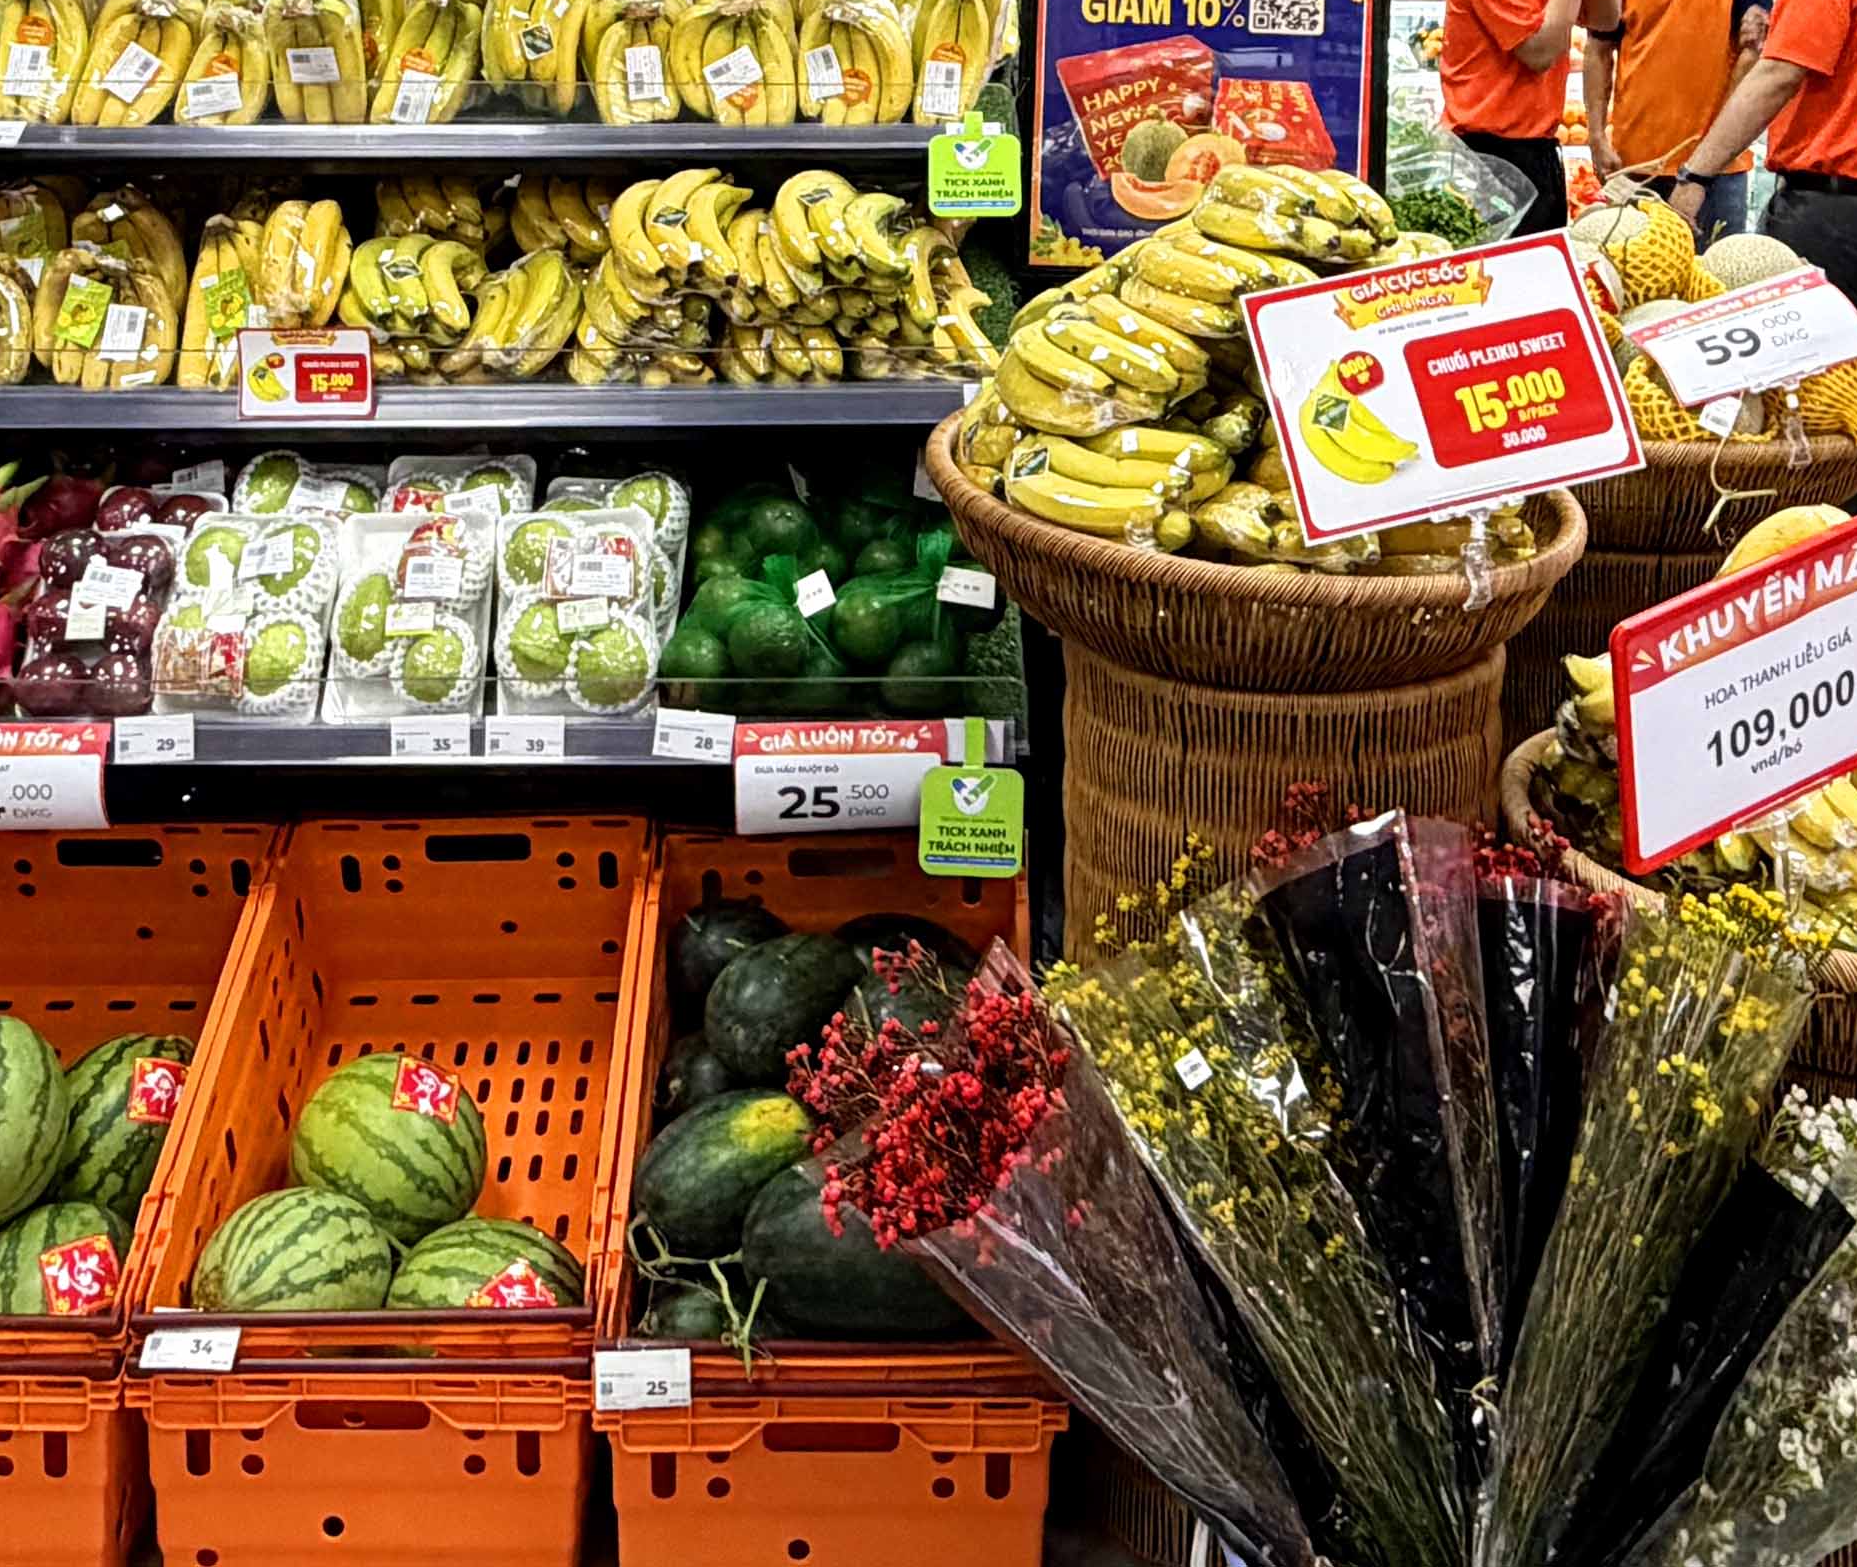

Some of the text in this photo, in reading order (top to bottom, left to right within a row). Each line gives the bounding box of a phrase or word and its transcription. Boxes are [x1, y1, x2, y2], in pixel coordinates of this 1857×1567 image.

[1083, 77, 1160, 111] HAPPY
[944, 177, 1005, 188] TICK XANH
[936, 187, 1014, 200] TRÁCH NHIỆM
[1350, 260, 1468, 303] GIÁ CỰC SỐC
[1427, 331, 1566, 377] CHUỐI PLEIKU SWEET
[1454, 368, 1566, 434] 15.000
[1657, 568, 1806, 672] KHUYẾN
[1704, 627, 1853, 710] HOA THANH LIỄU GIÁ
[1706, 669, 1855, 769] 109,000
[22, 726, 62, 752] TỐT
[156, 737, 175, 752] 29
[432, 737, 453, 752] 35
[524, 737, 547, 752] 39
[693, 735, 714, 751] 28
[760, 724, 899, 752] GIÁ LUÔN TỐT
[9, 783, 52, 802] .000
[777, 783, 890, 820] 25 .500
[936, 824, 1007, 839] TICK XANH
[927, 839, 1016, 856] TRÁCH NHIỆM
[190, 1338, 214, 1355] 34
[645, 1380, 668, 1397] 25
